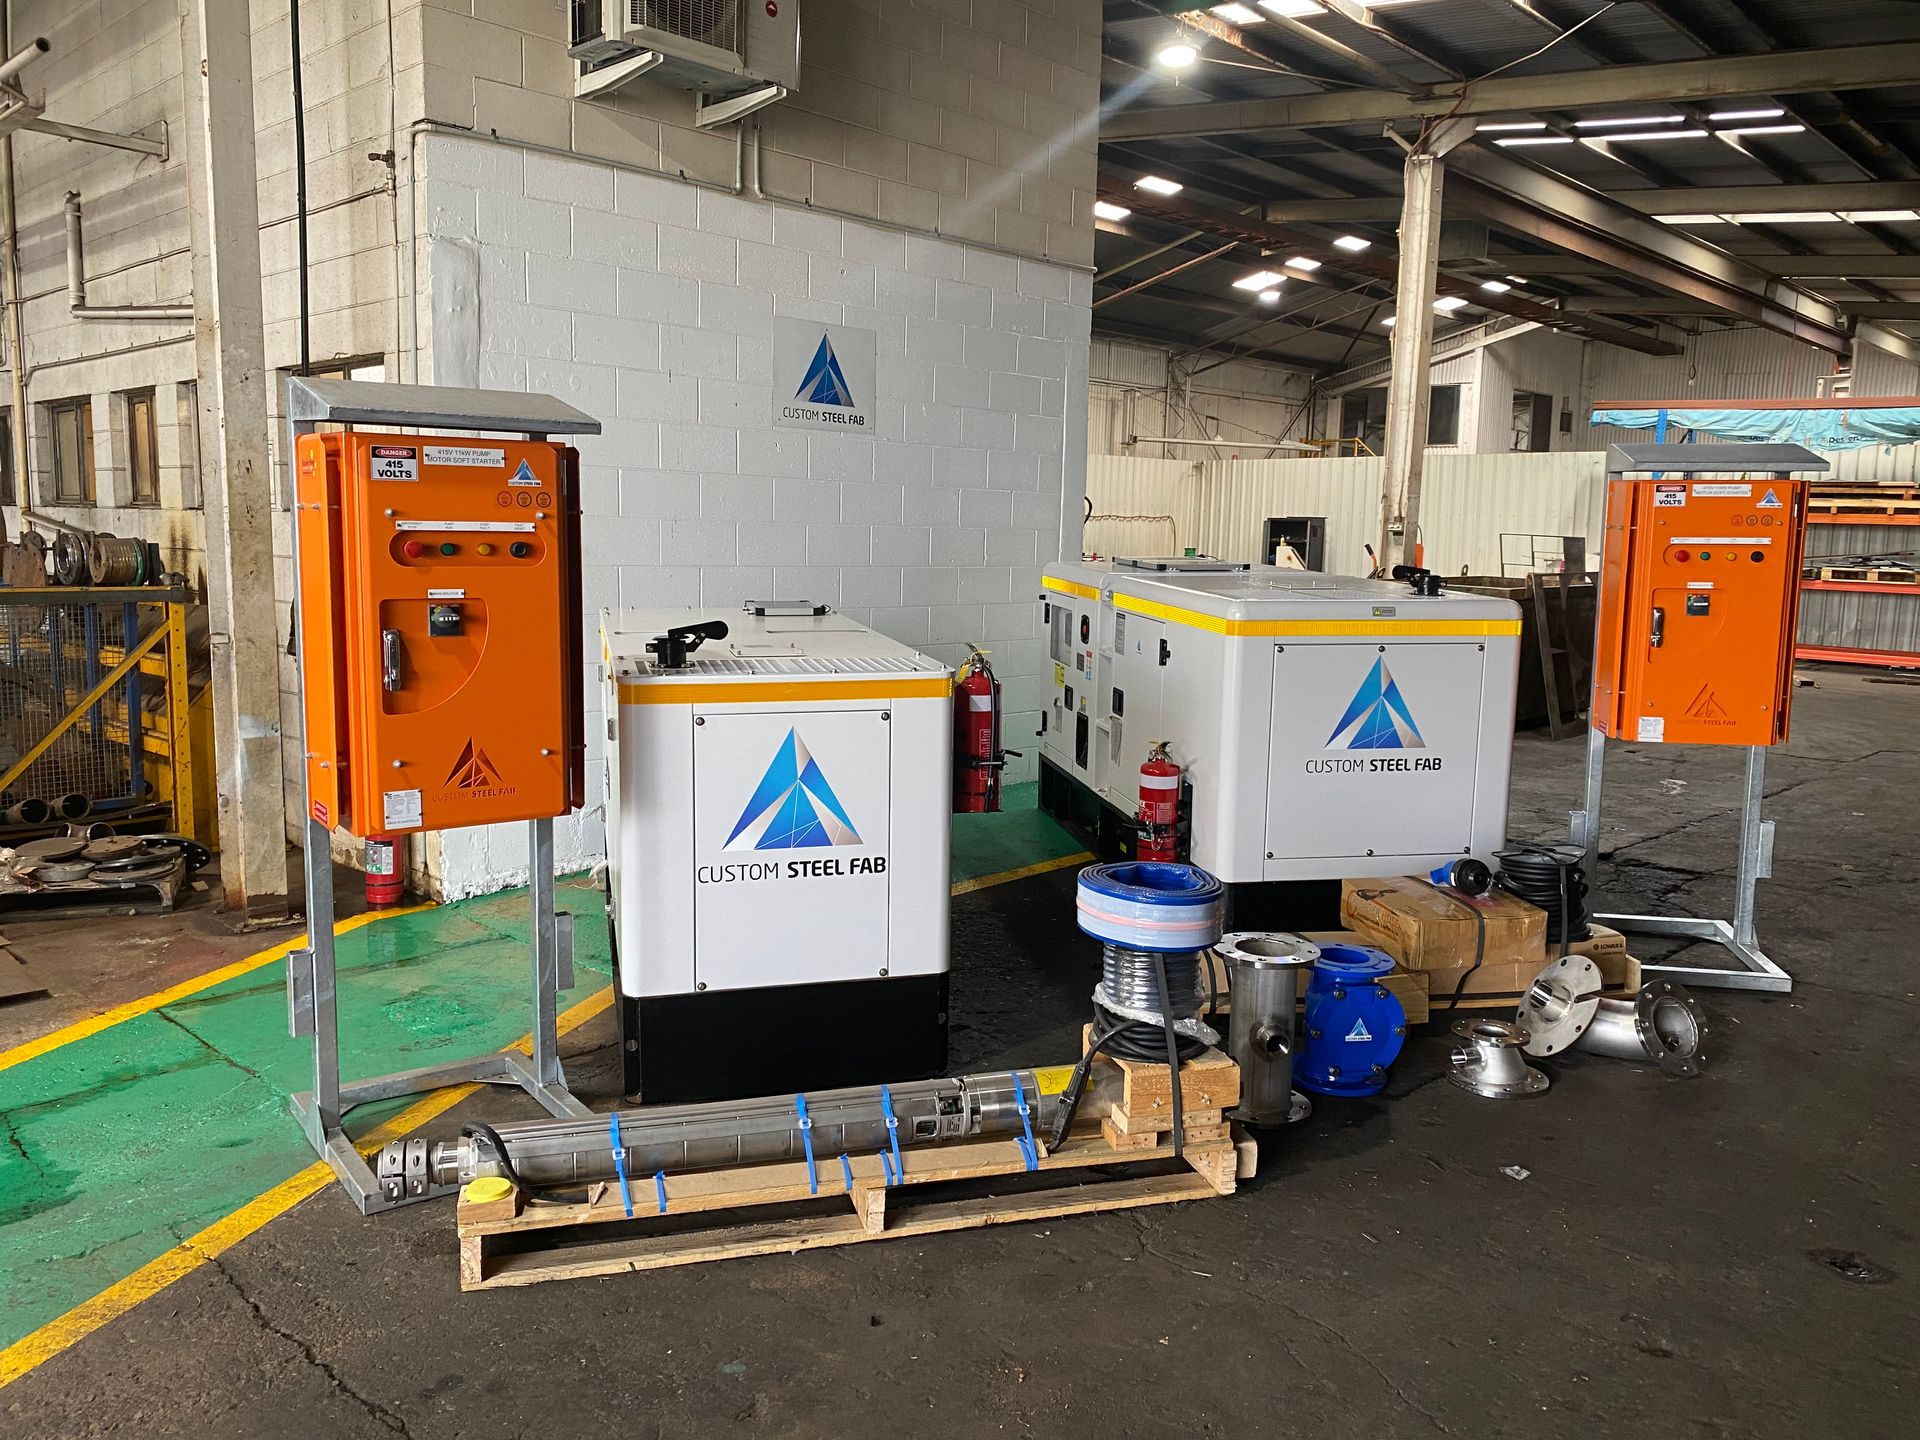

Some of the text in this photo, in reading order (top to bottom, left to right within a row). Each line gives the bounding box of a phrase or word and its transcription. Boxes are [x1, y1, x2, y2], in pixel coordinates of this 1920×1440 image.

[782, 406, 865, 426] CUSTOM STEEL FAB
[380, 448, 408, 456] DANGER
[385, 460, 404, 468] 415
[427, 455, 501, 465] MOTOR SOFT STARTER
[377, 469, 413, 479] VOLTS
[1305, 757, 1442, 774] CUSTOM STEEL FAB
[472, 789, 497, 798] STEEL
[697, 856, 887, 884] CUSTOM STEEL FAB
